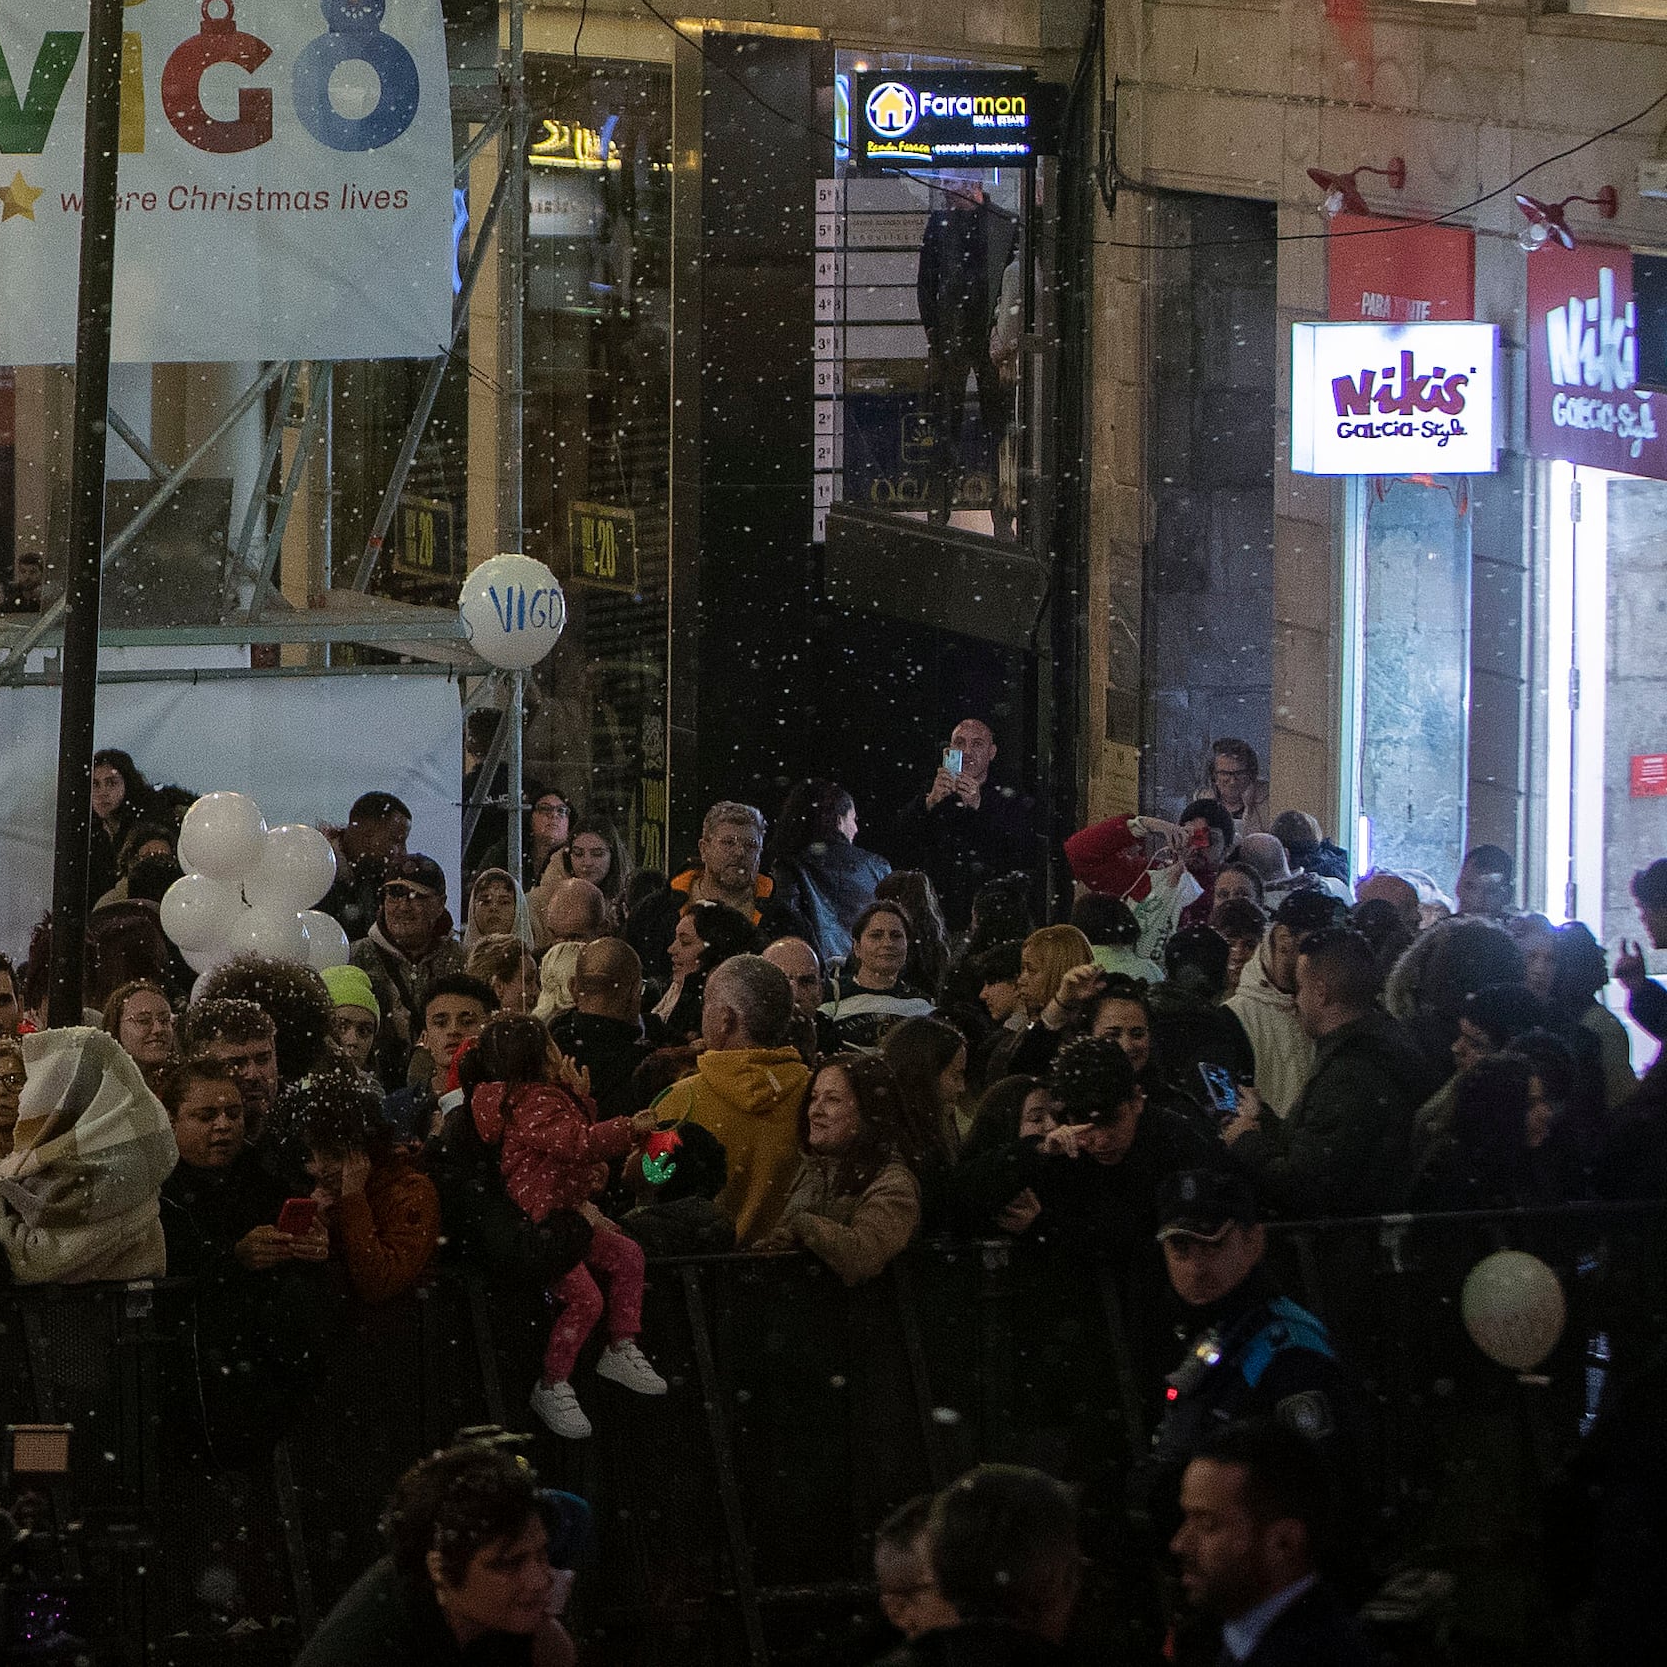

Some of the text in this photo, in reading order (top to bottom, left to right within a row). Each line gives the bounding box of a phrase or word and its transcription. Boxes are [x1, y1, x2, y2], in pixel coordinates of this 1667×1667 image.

[919, 92, 1025, 117] Faramon
[168, 184, 329, 214] Christmas
[341, 183, 409, 211] lives
[489, 582, 563, 632] VIGO
